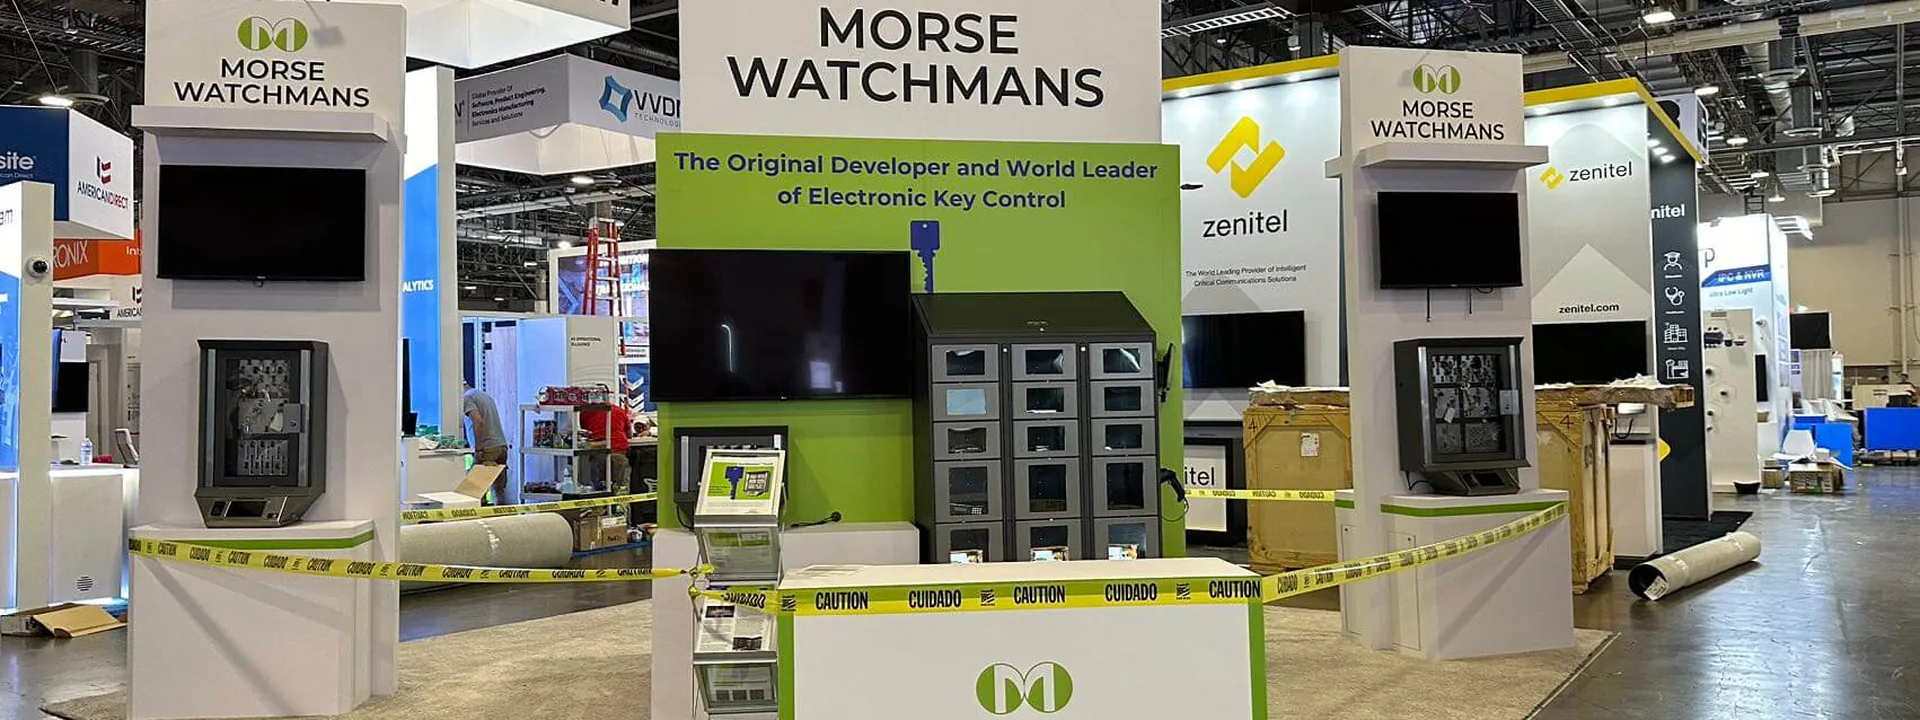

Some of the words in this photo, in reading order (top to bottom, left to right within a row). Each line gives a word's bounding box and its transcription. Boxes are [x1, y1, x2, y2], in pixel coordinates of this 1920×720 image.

[820, 7, 1019, 55] MORSE
[221, 58, 325, 81] MORSE
[727, 55, 1105, 108] WATCHMANS
[174, 82, 370, 107] WATCHMANS
[1402, 100, 1474, 119] MORSE
[1371, 120, 1505, 141] WATCHMANS
[674, 152, 721, 172] The
[727, 153, 823, 176] Original
[832, 156, 951, 180] Developer
[957, 158, 1000, 178] and
[1006, 159, 1075, 179] World
[1082, 160, 1159, 180] Leader
[1569, 162, 1632, 183] zenitel
[778, 187, 801, 206] of
[808, 187, 927, 208] Electronic
[933, 189, 976, 212] Key
[982, 189, 1066, 209] Control
[1651, 204, 1685, 219] nitel
[1203, 208, 1287, 238] zenitel
[1197, 269, 1215, 277] World
[1216, 267, 1240, 277] Leading
[1241, 266, 1266, 274] Provider
[1267, 265, 1275, 273] of
[1275, 263, 1307, 273] Intelligent
[1216, 277, 1266, 285] Communications
[1267, 275, 1297, 283] Solutions
[1744, 269, 1765, 280] NVR
[1738, 287, 1753, 296] Light
[1558, 303, 1619, 314] zenitel.com
[228, 550, 252, 565] CAUTION
[264, 555, 288, 569] CUIDADO
[307, 558, 334, 572] CAUTION
[346, 561, 376, 575] CUIDADO
[396, 564, 427, 577] CAUTION
[815, 591, 868, 610] CAUTION
[908, 590, 962, 608] CUIDADO
[1013, 585, 1065, 604] CAUTION
[1105, 583, 1158, 602] CUIDADO
[1209, 580, 1261, 599] CAUTION
